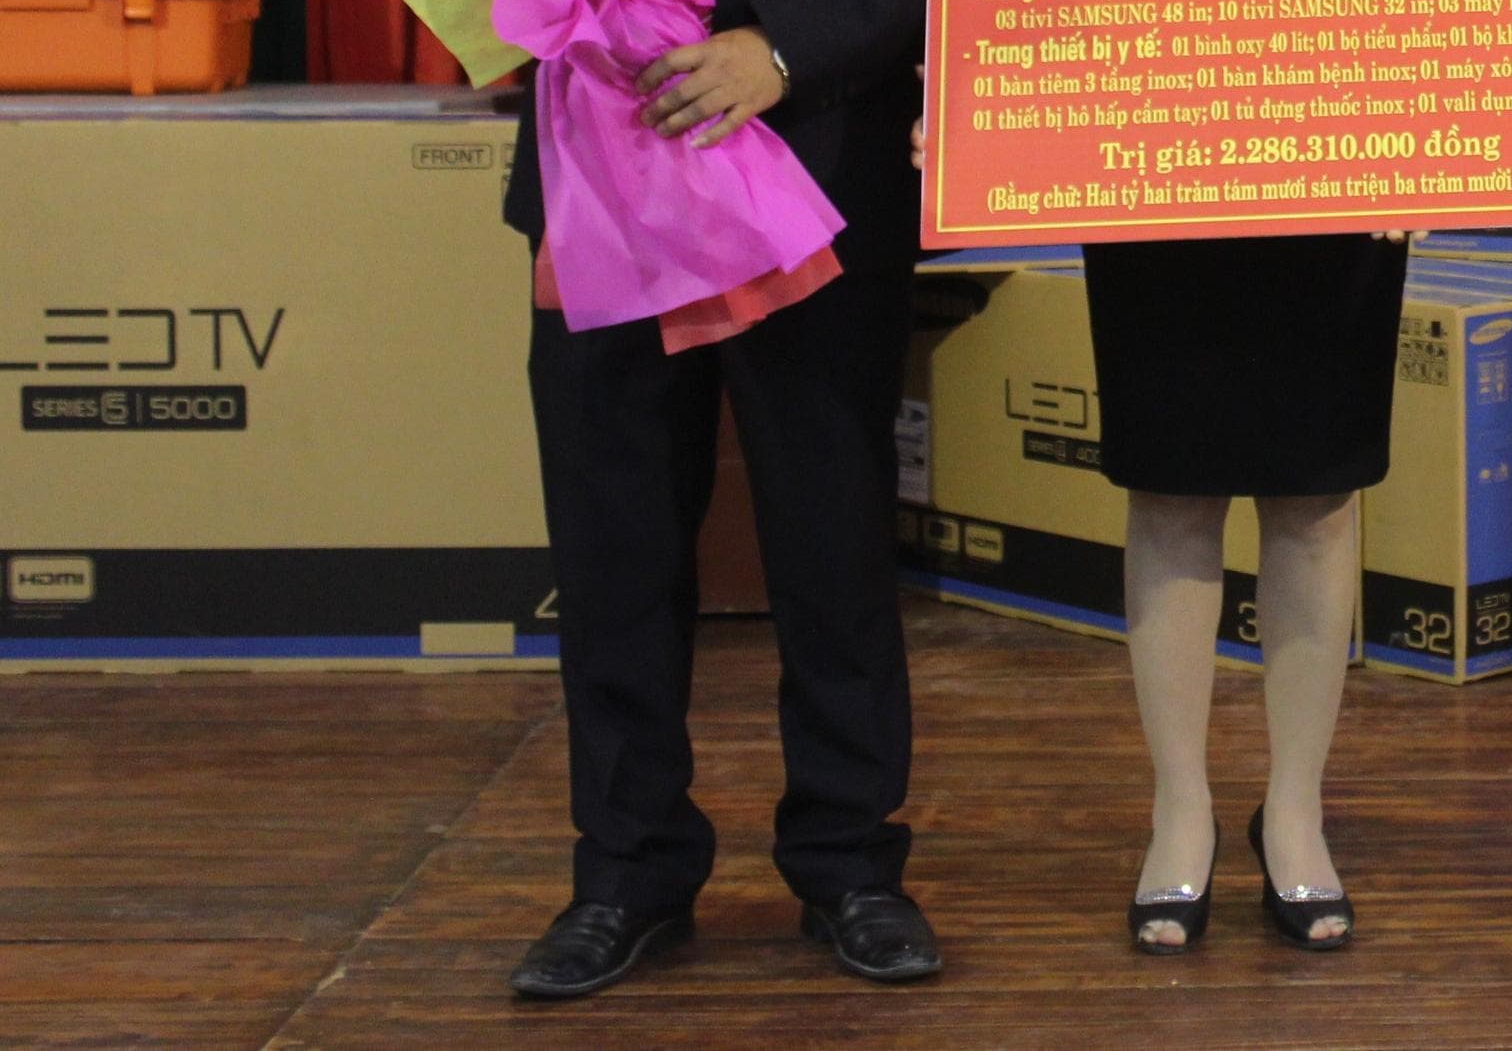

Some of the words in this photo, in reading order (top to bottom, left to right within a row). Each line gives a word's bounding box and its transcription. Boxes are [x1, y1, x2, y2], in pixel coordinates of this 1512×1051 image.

[996, 9, 1016, 30] 03
[1022, 7, 1052, 29] tivi
[1058, 3, 1157, 27] SAMSUNG
[1162, 3, 1183, 23] 48
[1189, 1, 1212, 25] in;
[1219, 0, 1238, 21] 10
[1243, 0, 1273, 20] tivi
[974, 76, 993, 98] 01
[1000, 75, 1033, 97] bàn
[1039, 72, 1080, 95] tiêm
[1085, 72, 1095, 93] 3
[1101, 66, 1142, 95] tầng
[1148, 70, 1193, 91] inox;
[1197, 67, 1216, 89] 01
[1223, 65, 1256, 87] bàn
[1263, 64, 1314, 86] khám
[1320, 62, 1365, 88] bệnh
[1372, 61, 1416, 84] inox;
[1420, 59, 1440, 80] 01
[1446, 58, 1485, 82] máy
[421, 148, 485, 165] FRONT
[1100, 141, 1146, 175] Trị
[1156, 139, 1211, 173] giá:
[1220, 132, 1415, 165] 2.286.310.000
[1424, 123, 1501, 162] đồng
[988, 182, 1040, 215] (Bằng
[1044, 184, 1081, 208] chữ:
[1086, 182, 1116, 207] Hai
[1121, 179, 1139, 211] tỷ
[1144, 180, 1171, 205] hai
[1176, 180, 1219, 204] trăm
[1224, 179, 1258, 202] tám
[1262, 175, 1306, 200] mươi
[1311, 175, 1341, 198] sáu
[1346, 172, 1389, 202] triệu
[1394, 171, 1416, 195] ba
[1420, 172, 1464, 194] trăm
[1468, 167, 1512, 192] mười
[31, 398, 98, 418] SERIES
[150, 396, 238, 421] 5000
[1404, 607, 1451, 655] 32
[1475, 612, 1512, 646] 32
